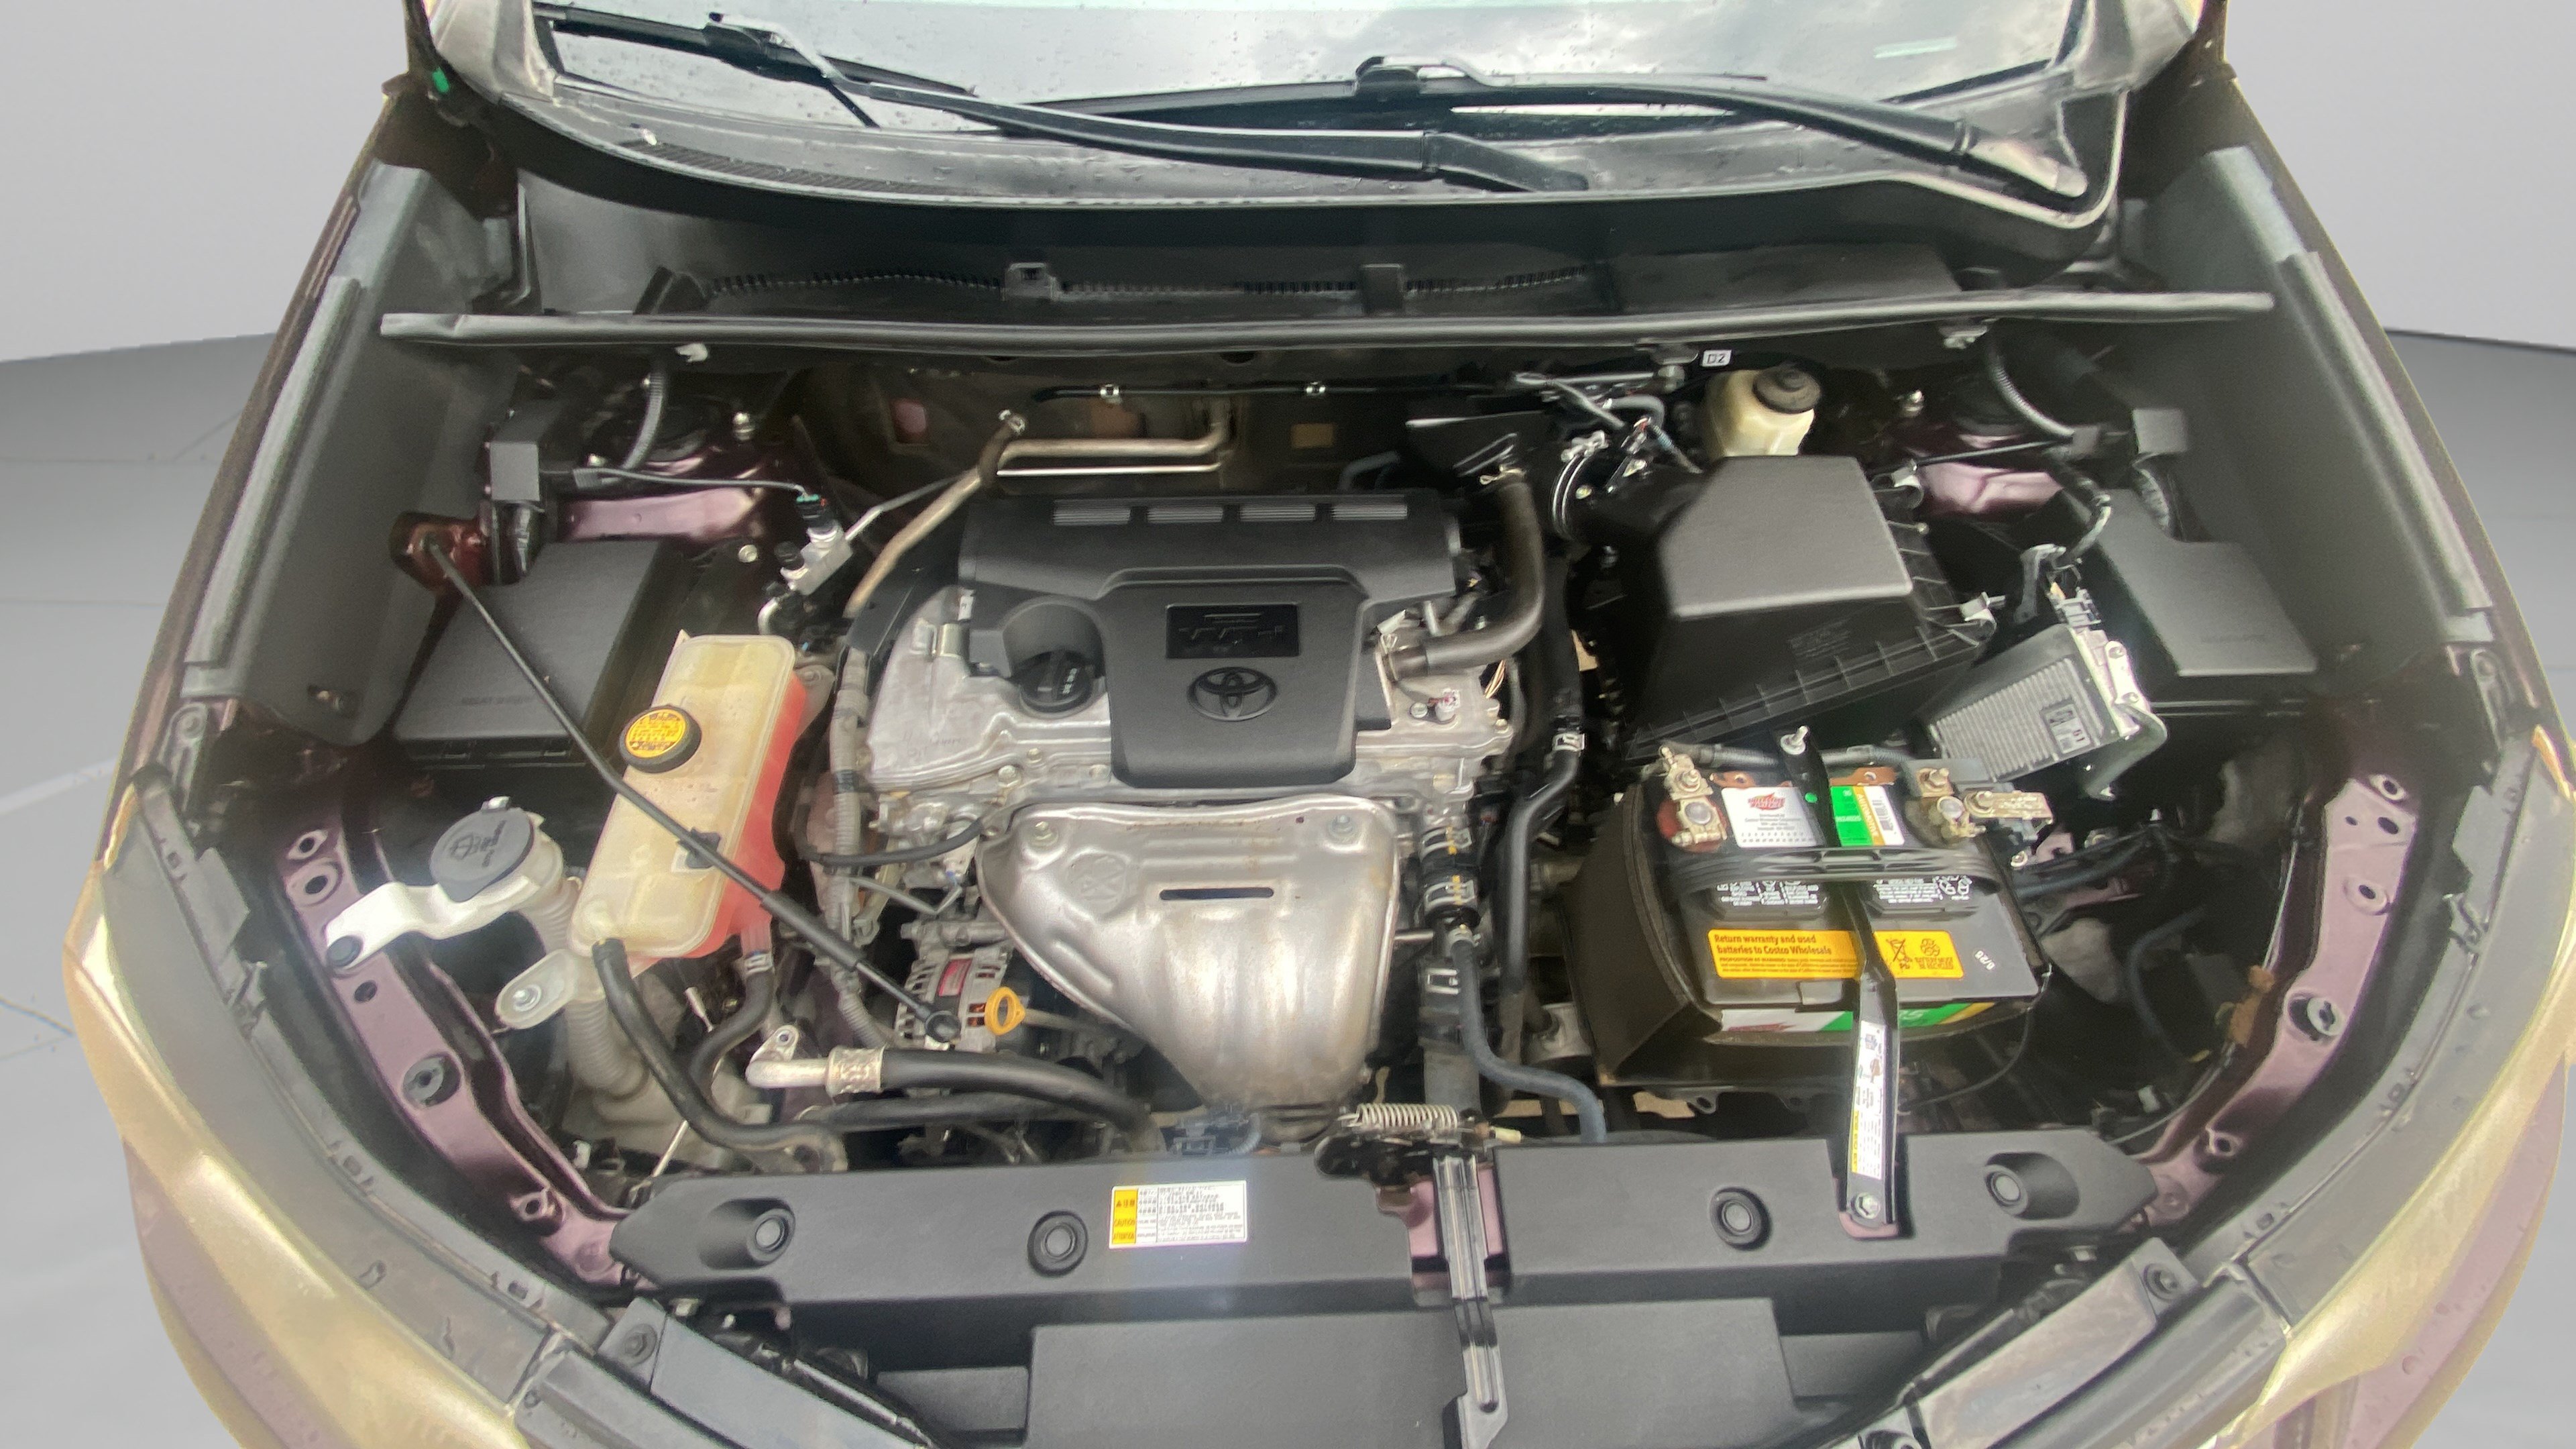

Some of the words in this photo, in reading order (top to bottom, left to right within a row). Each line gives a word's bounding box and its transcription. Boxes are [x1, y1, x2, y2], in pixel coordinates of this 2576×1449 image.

[1714, 934, 1742, 943] Return
[1743, 935, 1779, 945] warranty
[1781, 934, 1795, 943] and
[1797, 934, 1816, 943] used
[1717, 945, 1752, 954] batteries
[1764, 946, 1789, 954] Costco
[1790, 945, 1832, 954] Wholesale
